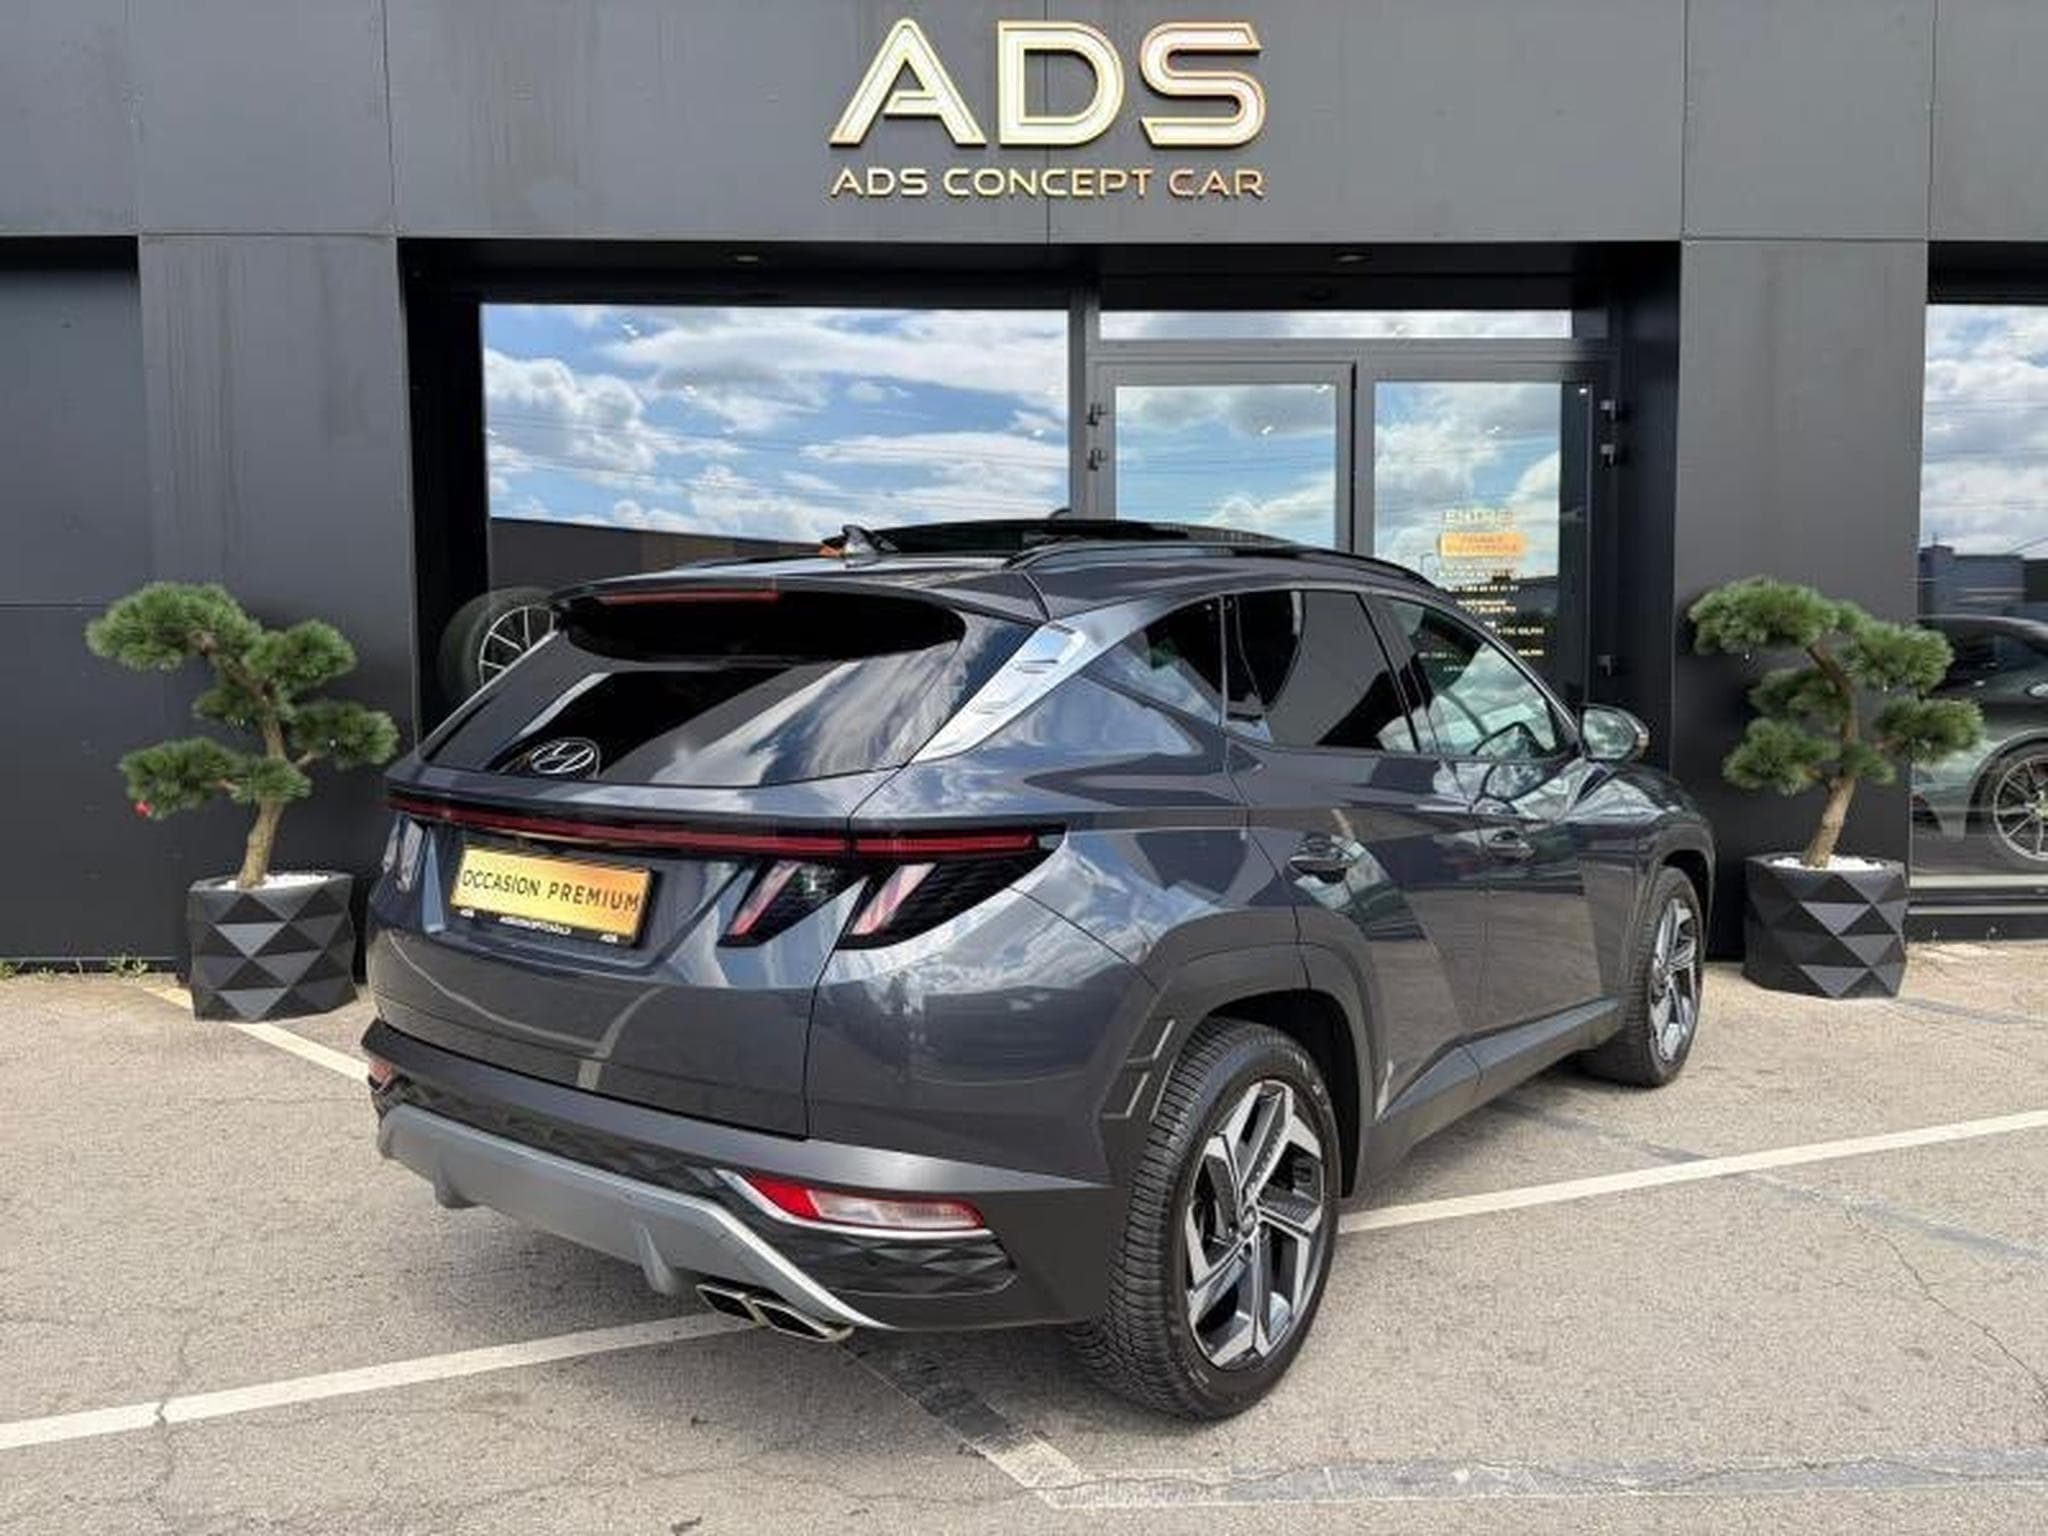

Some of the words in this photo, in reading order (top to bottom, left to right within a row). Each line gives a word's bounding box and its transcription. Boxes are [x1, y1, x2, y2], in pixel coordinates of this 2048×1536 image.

[829, 17, 1268, 147] ADS
[831, 168, 929, 198] ADS
[943, 168, 1154, 198] CONCEPT
[1168, 168, 1267, 198] CAR
[462, 869, 541, 898] OCCASION
[547, 882, 640, 912] PREMIUM
